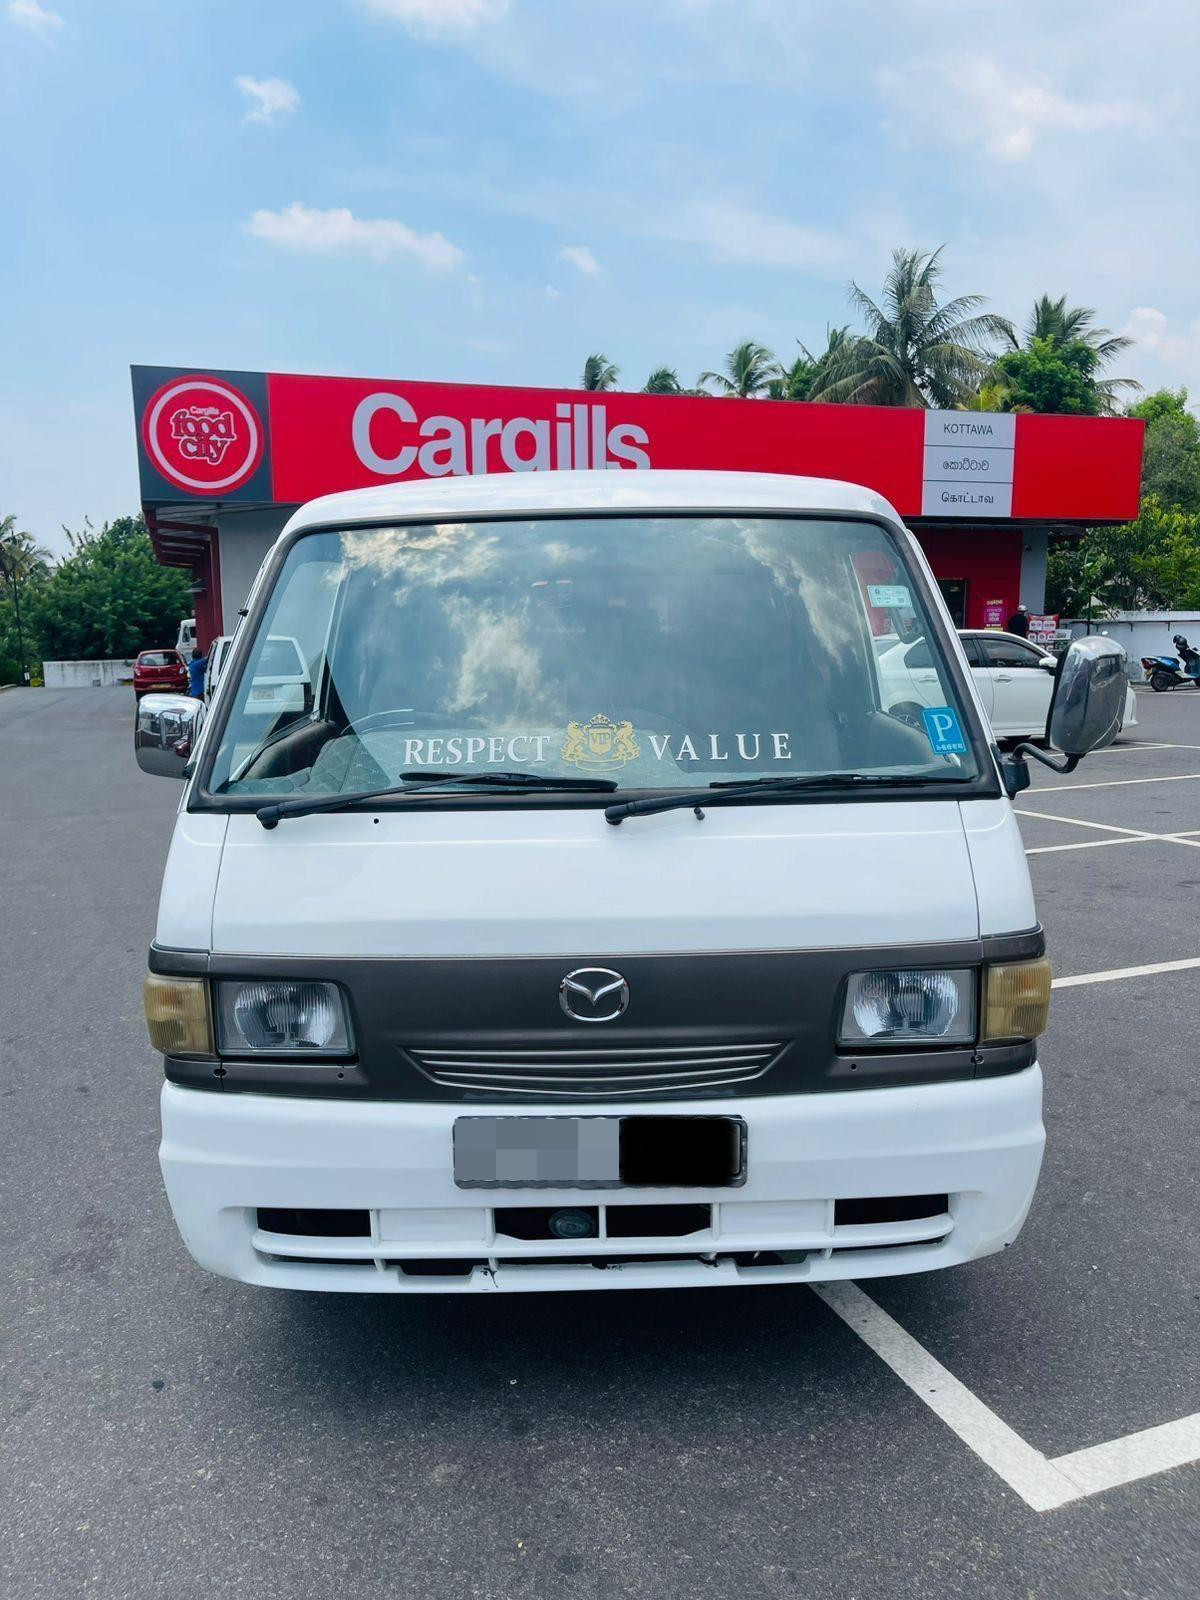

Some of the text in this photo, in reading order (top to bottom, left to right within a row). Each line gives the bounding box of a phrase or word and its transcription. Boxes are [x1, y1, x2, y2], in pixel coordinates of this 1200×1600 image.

[170, 409, 236, 440] food
[352, 392, 650, 476] Cargills
[943, 423, 994, 435] KOTTAWA
[179, 435, 230, 465] city
[942, 457, 990, 471] කොට්ටාව
[941, 491, 994, 504] கொட்டாவ
[590, 732, 610, 745] VIP
[930, 714, 953, 742] P
[402, 733, 792, 765] RESPECT VALUE
